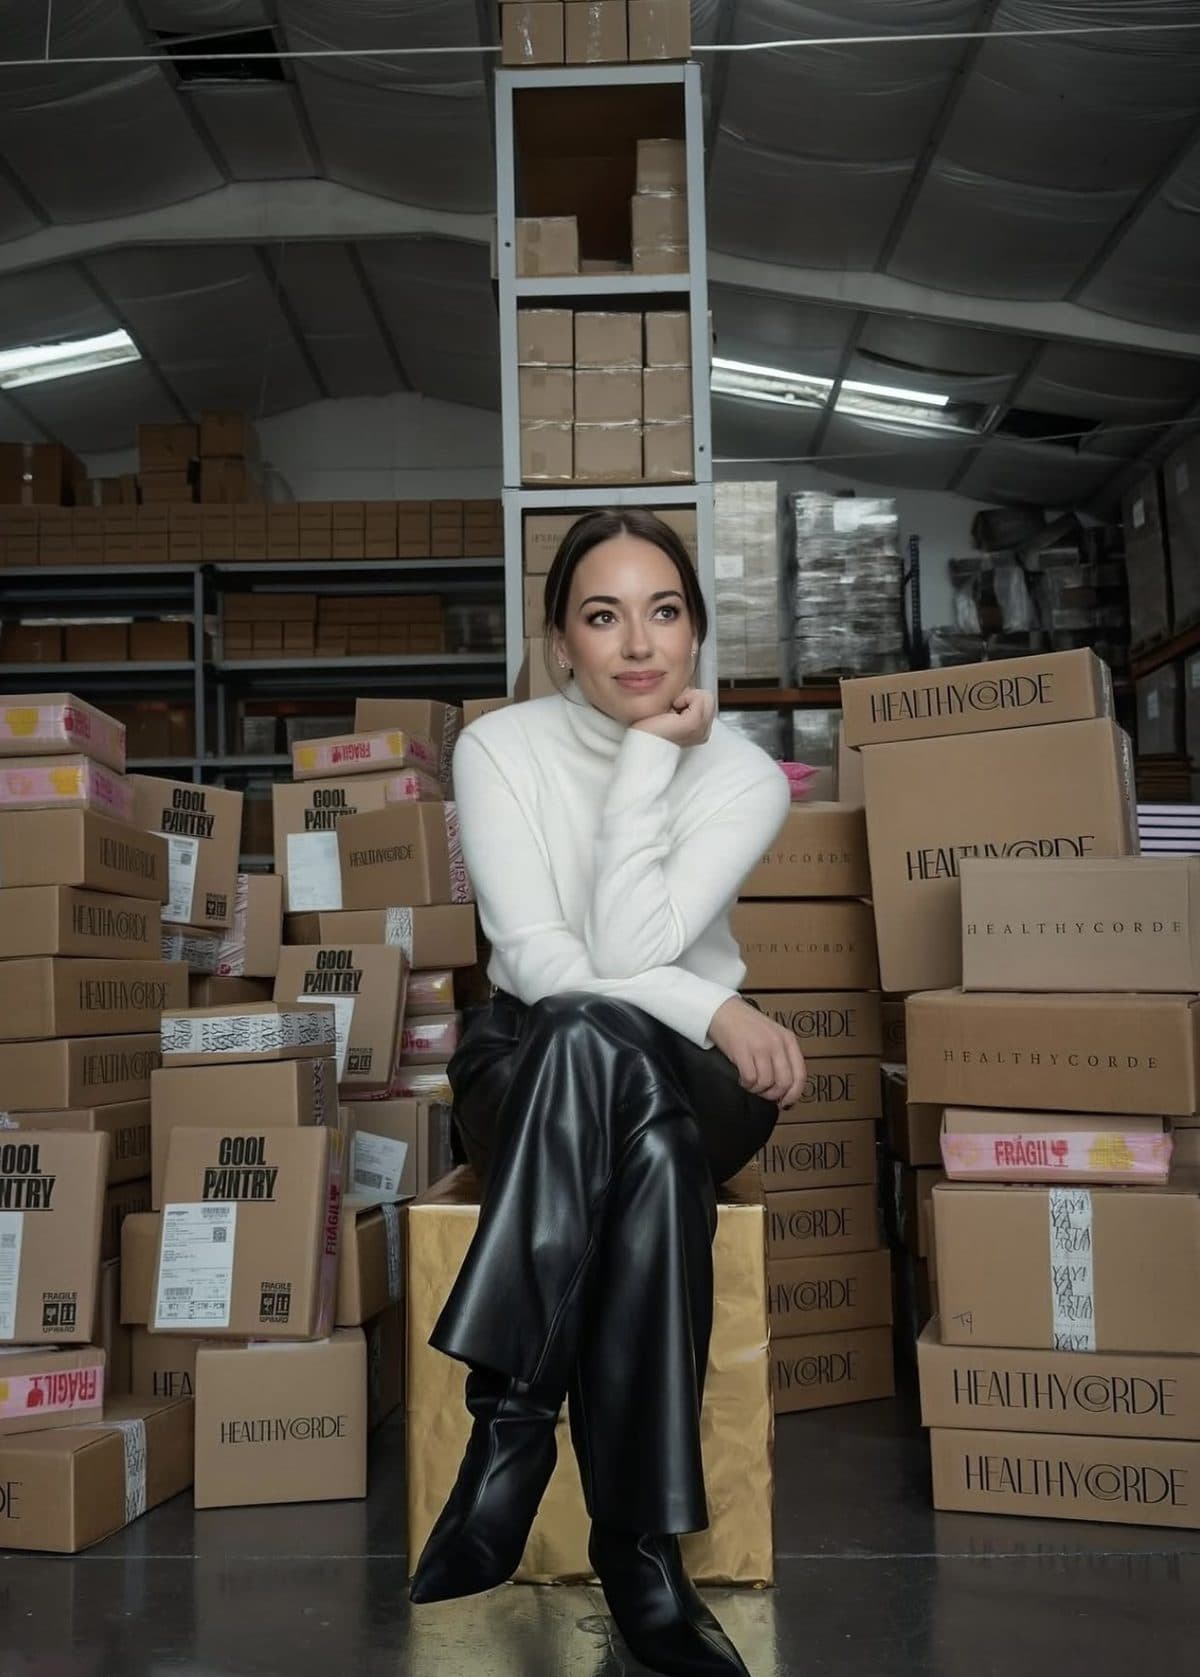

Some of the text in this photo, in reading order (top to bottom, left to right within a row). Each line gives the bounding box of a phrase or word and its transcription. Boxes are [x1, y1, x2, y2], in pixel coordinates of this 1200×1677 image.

[173, 788, 207, 812] COOL
[313, 789, 348, 808] COOL
[162, 810, 215, 838] PANTRY
[967, 921, 1184, 936] HEALTHYCORDE
[316, 950, 354, 969] COOL
[303, 971, 364, 993] PANTRY
[944, 1049, 1159, 1070] HEALTHYCORDE
[0, 1144, 42, 1174] OOL
[218, 1137, 267, 1165] COOL
[0, 1178, 56, 1208] NTRY
[203, 1169, 278, 1199] PANTRY
[43, 1292, 78, 1300] FRAGILE
